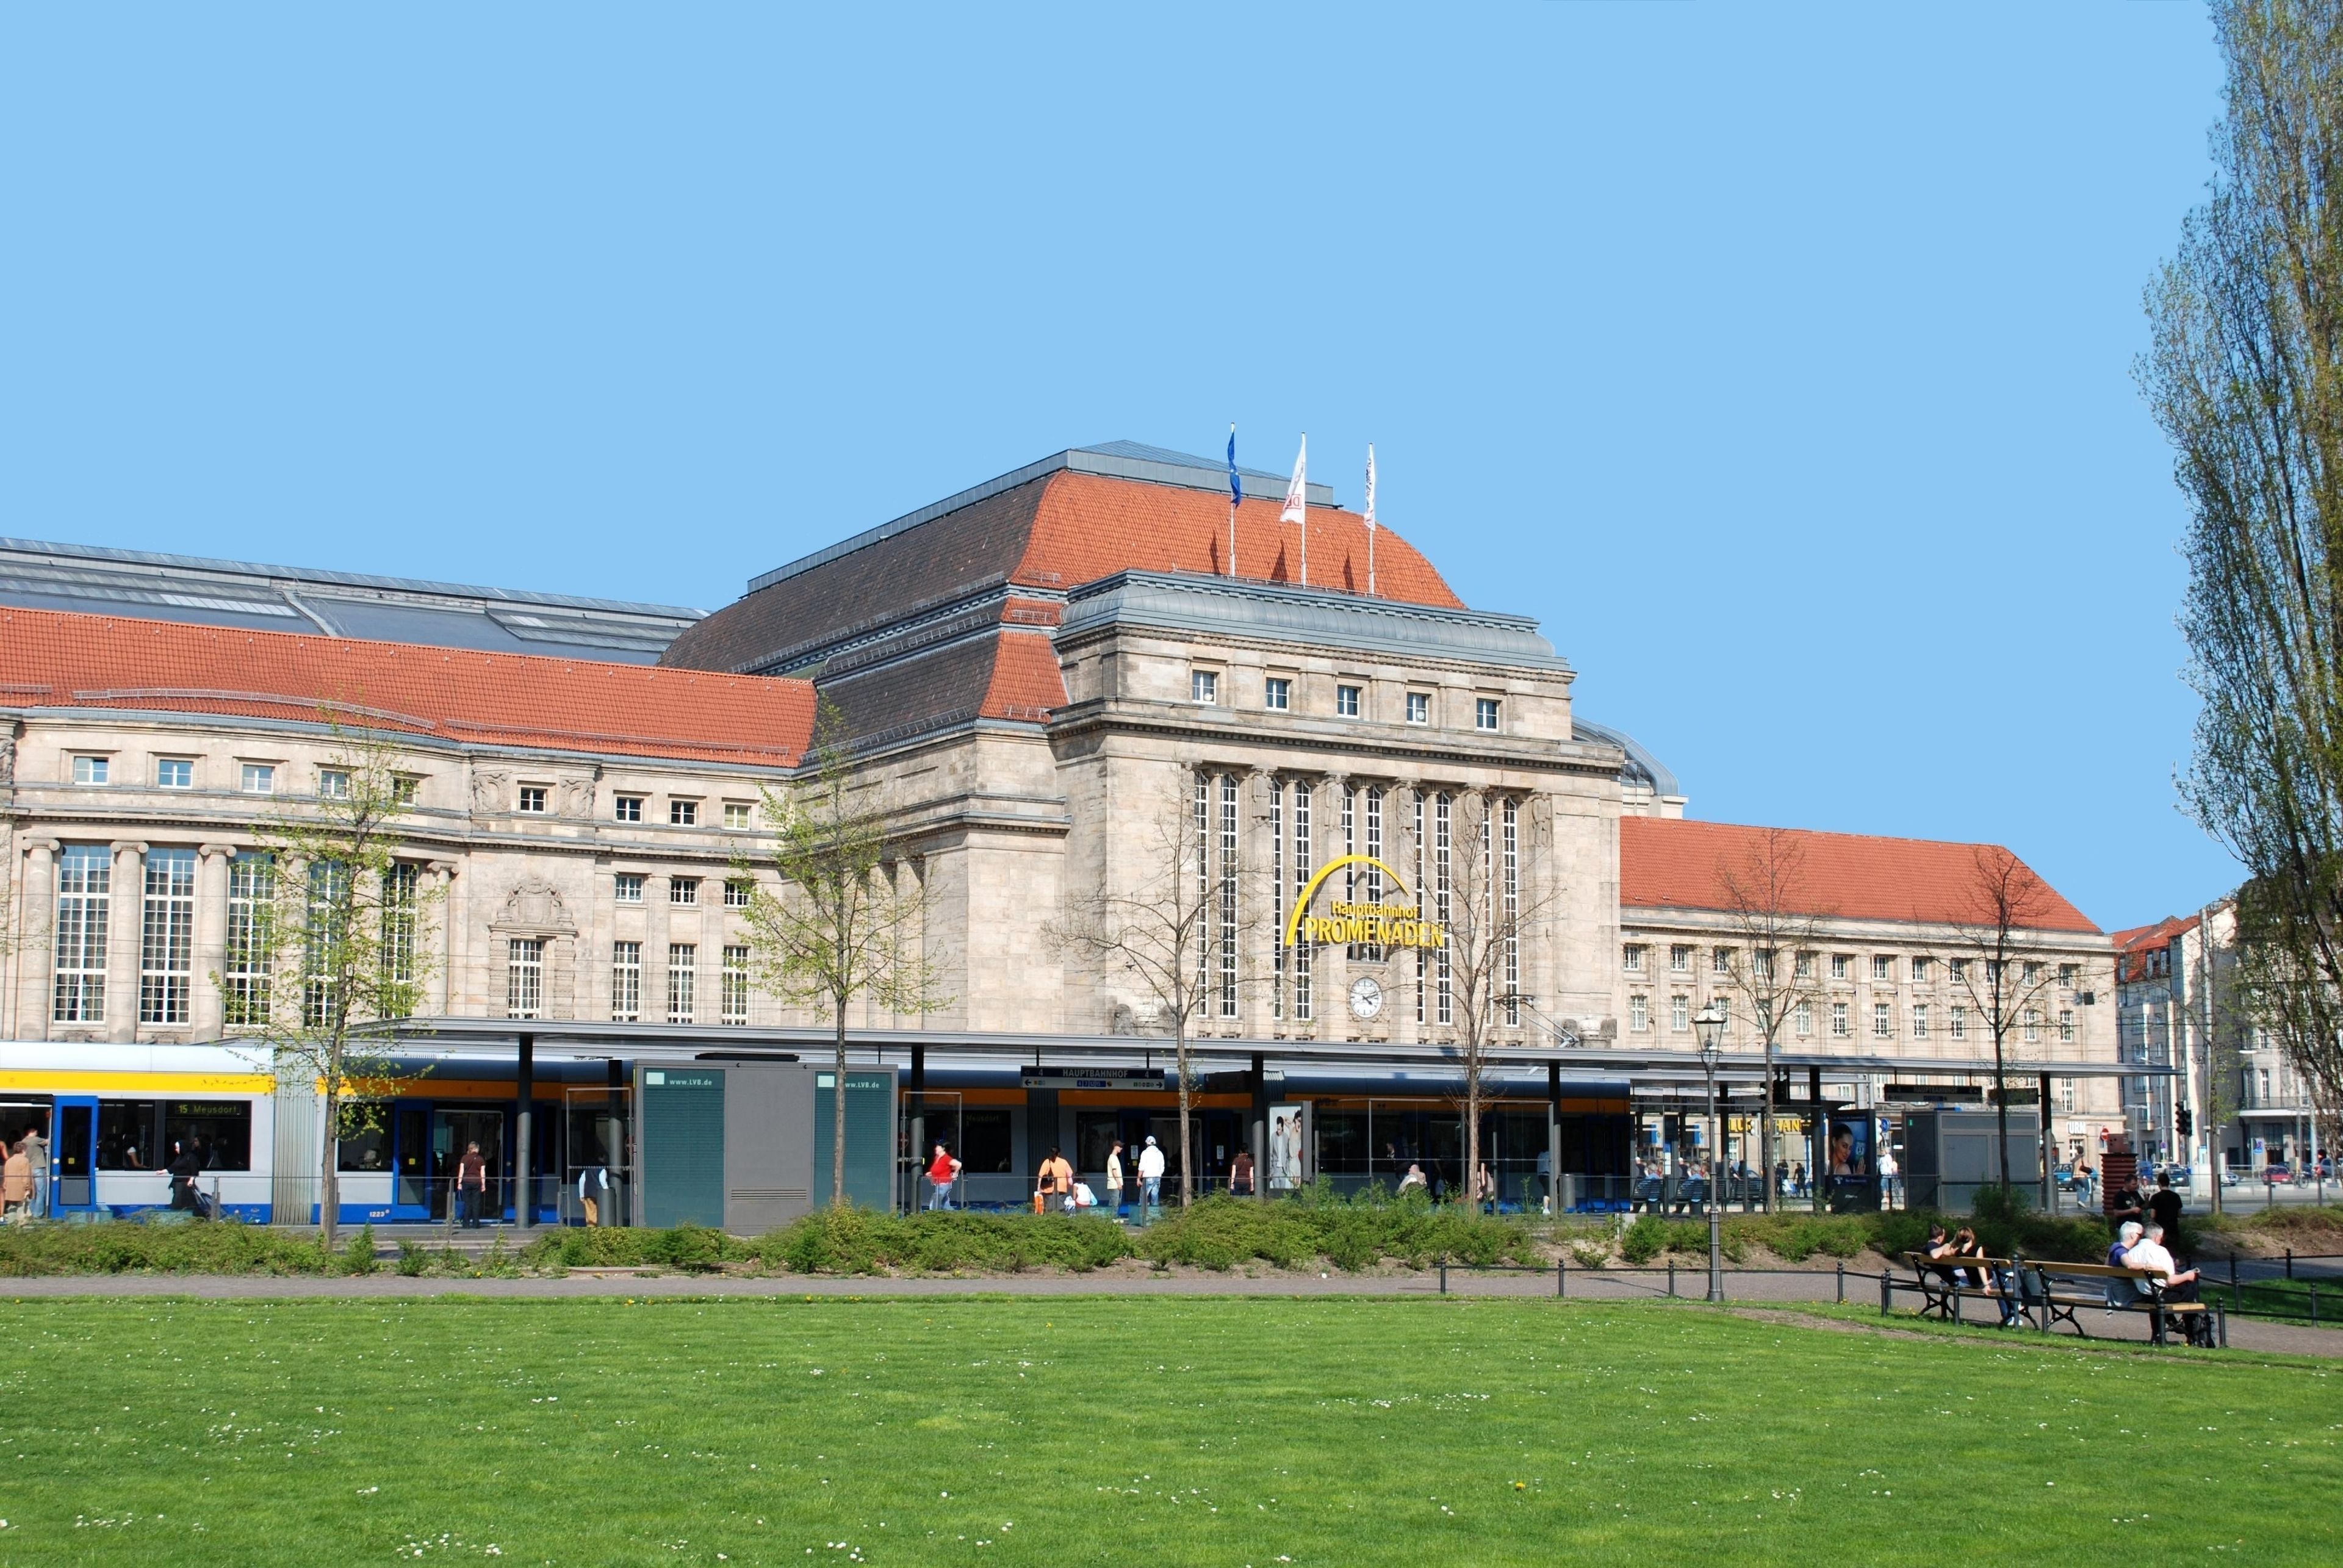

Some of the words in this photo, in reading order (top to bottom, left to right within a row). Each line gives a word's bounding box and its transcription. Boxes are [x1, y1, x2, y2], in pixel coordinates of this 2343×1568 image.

[1331, 901, 1418, 918] Hauptbahnhof
[1305, 917, 1444, 948] PROMENADEN
[1062, 1069, 1128, 1078] HAUPTBAHNHOF
[179, 1104, 188, 1113] 15
